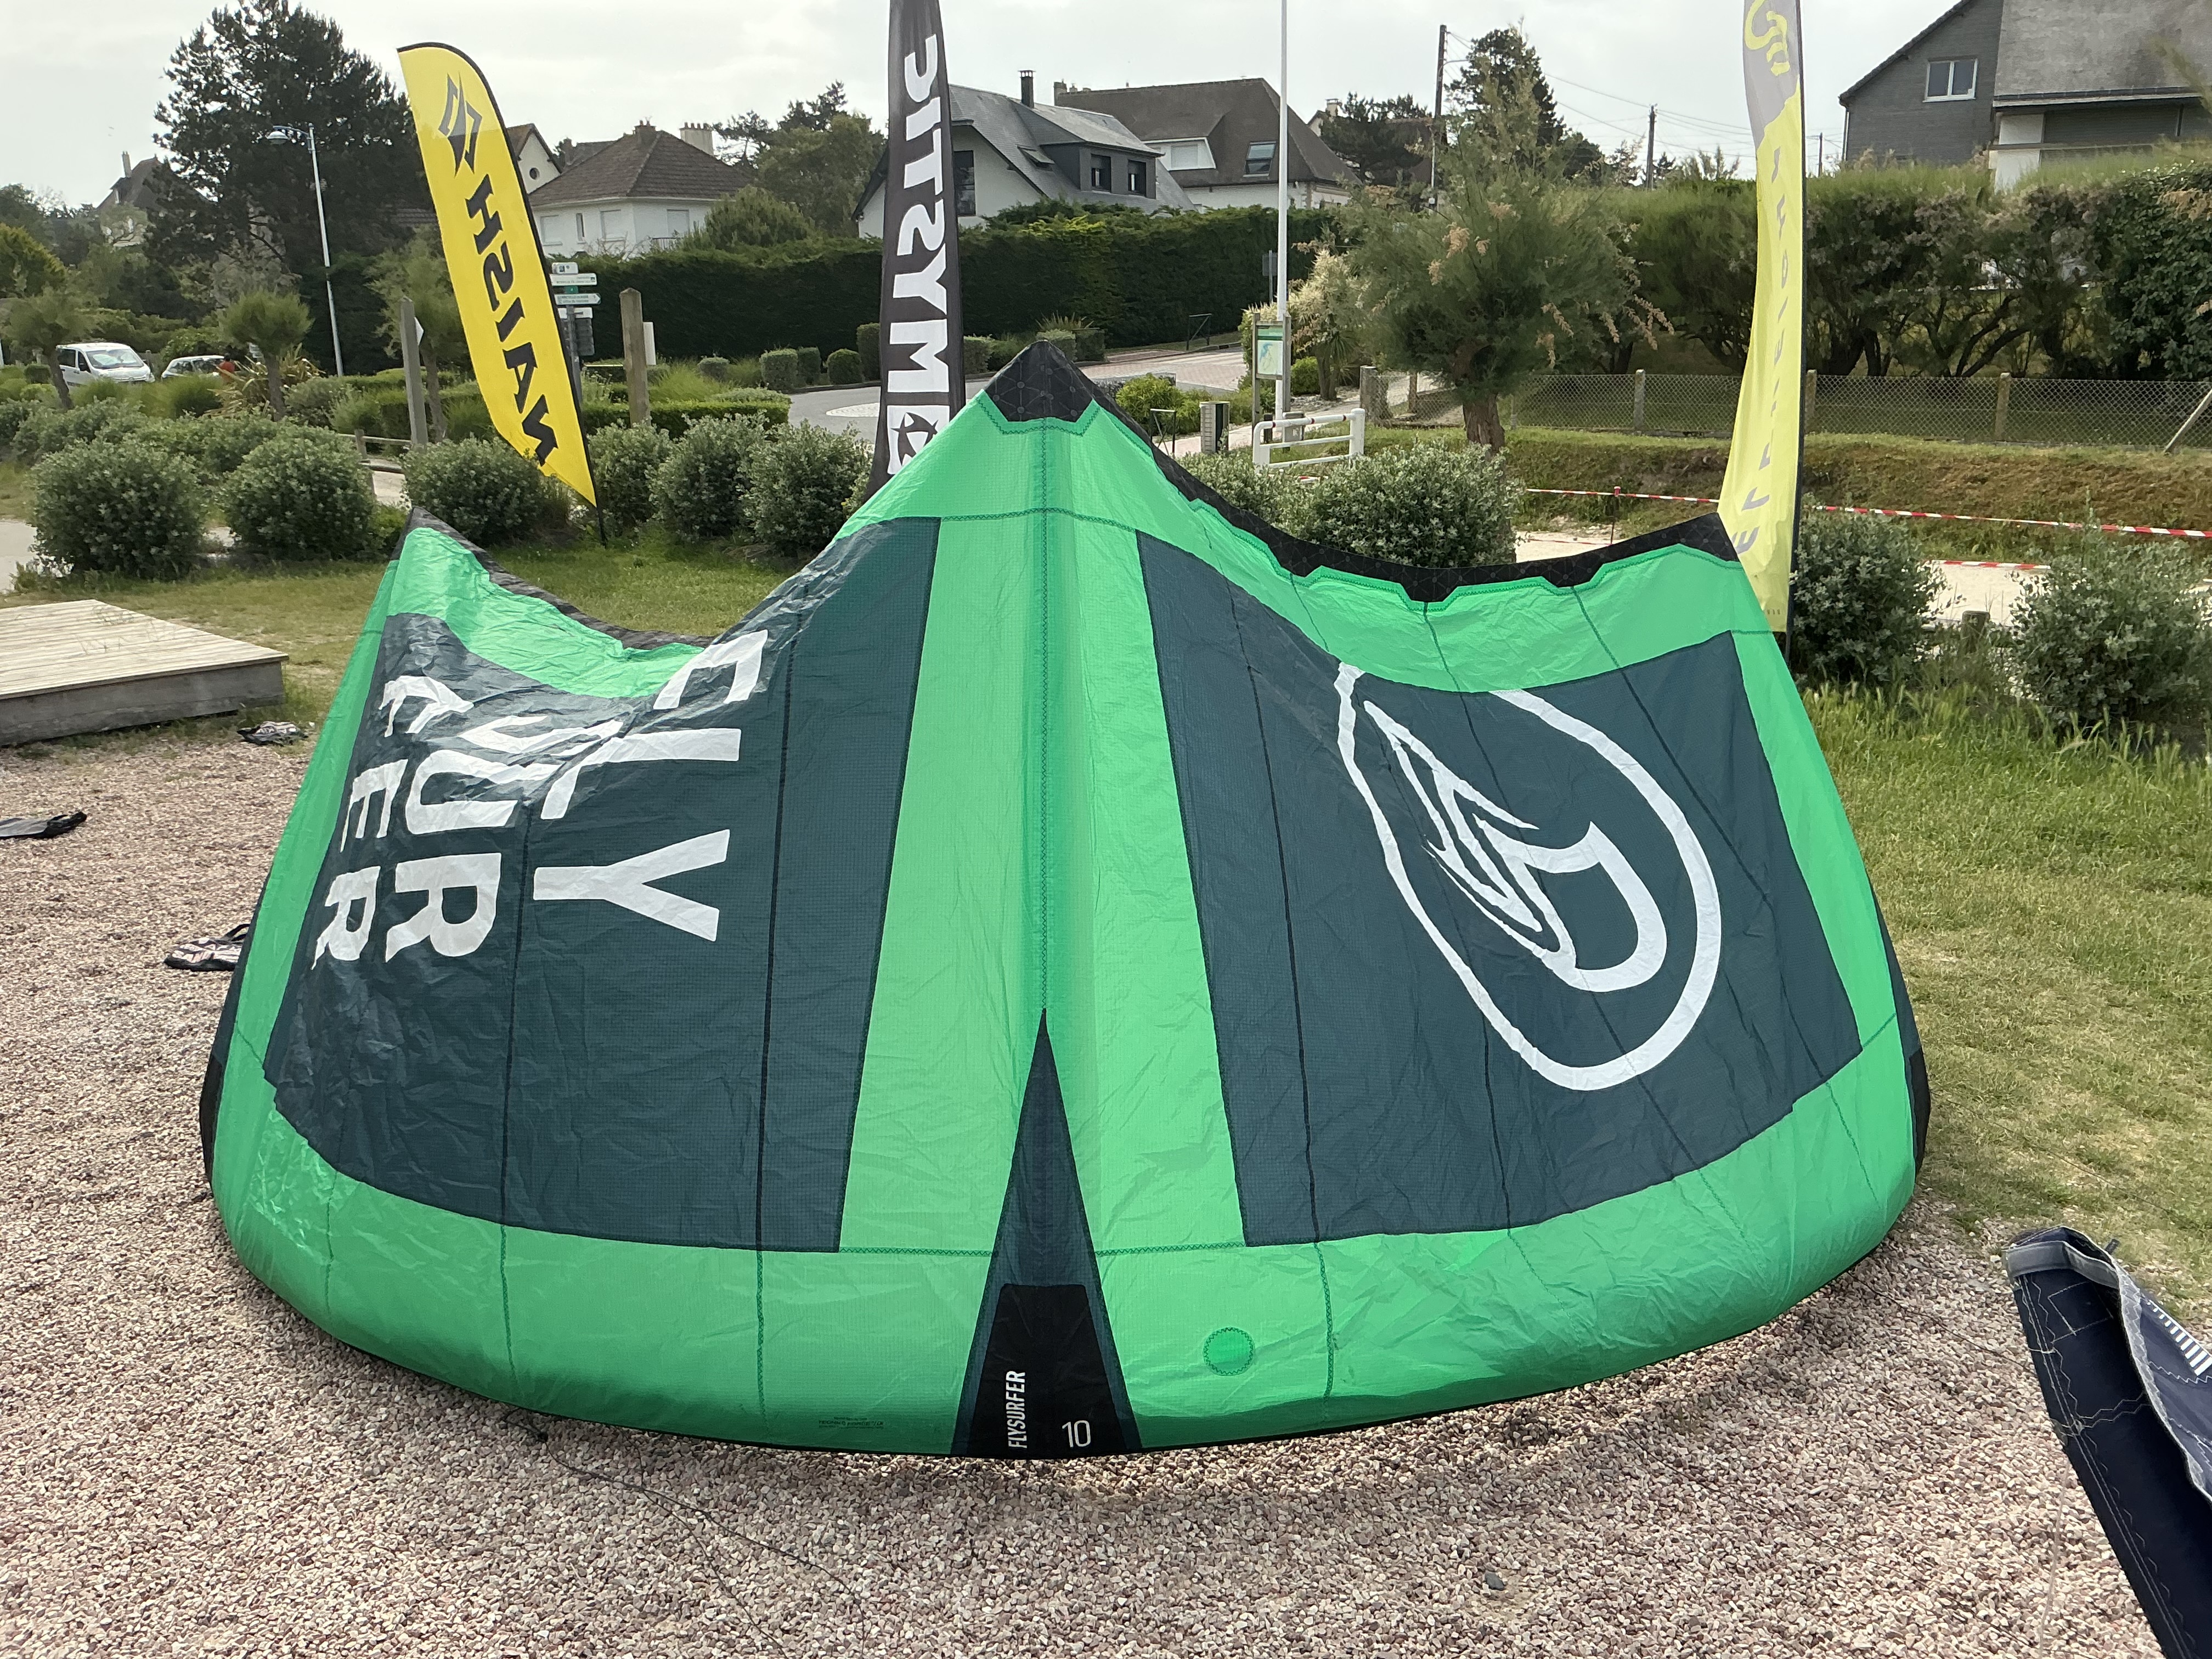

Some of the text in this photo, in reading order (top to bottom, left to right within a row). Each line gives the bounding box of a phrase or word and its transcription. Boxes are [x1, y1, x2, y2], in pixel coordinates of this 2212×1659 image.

[311, 675, 475, 970] FER
[534, 629, 769, 942] FLY
[1006, 1370, 1028, 1449] FLYSURFER
[1062, 1420, 1091, 1448] 10
